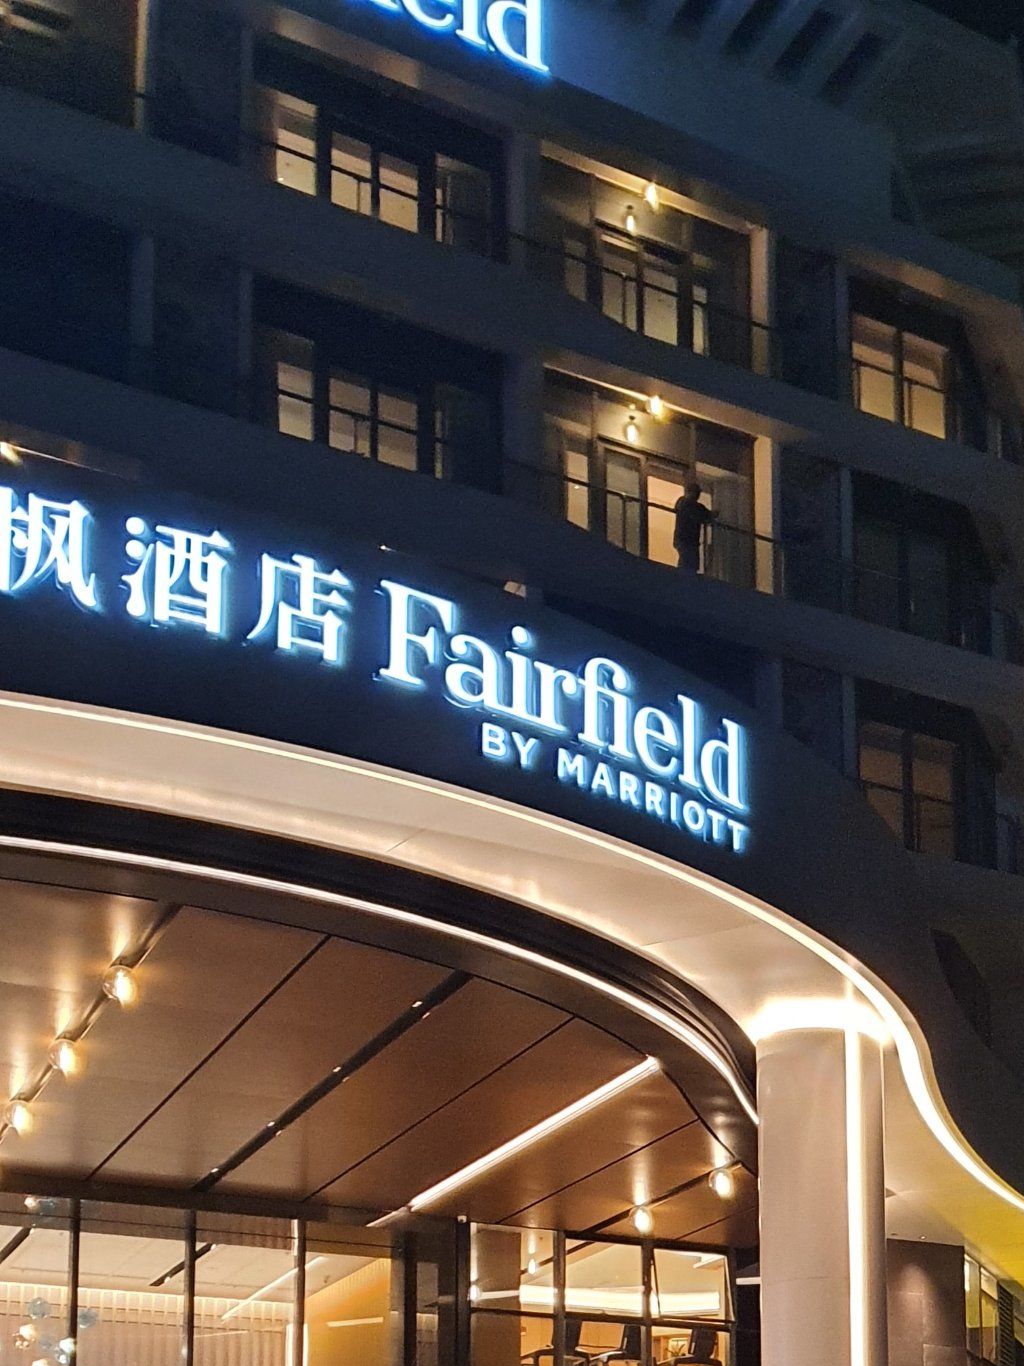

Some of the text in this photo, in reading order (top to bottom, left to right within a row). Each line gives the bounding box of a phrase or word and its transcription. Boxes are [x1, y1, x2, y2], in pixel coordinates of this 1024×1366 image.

[378, 579, 750, 812] Fairfield
[480, 721, 750, 854] BY MARRIOTT
